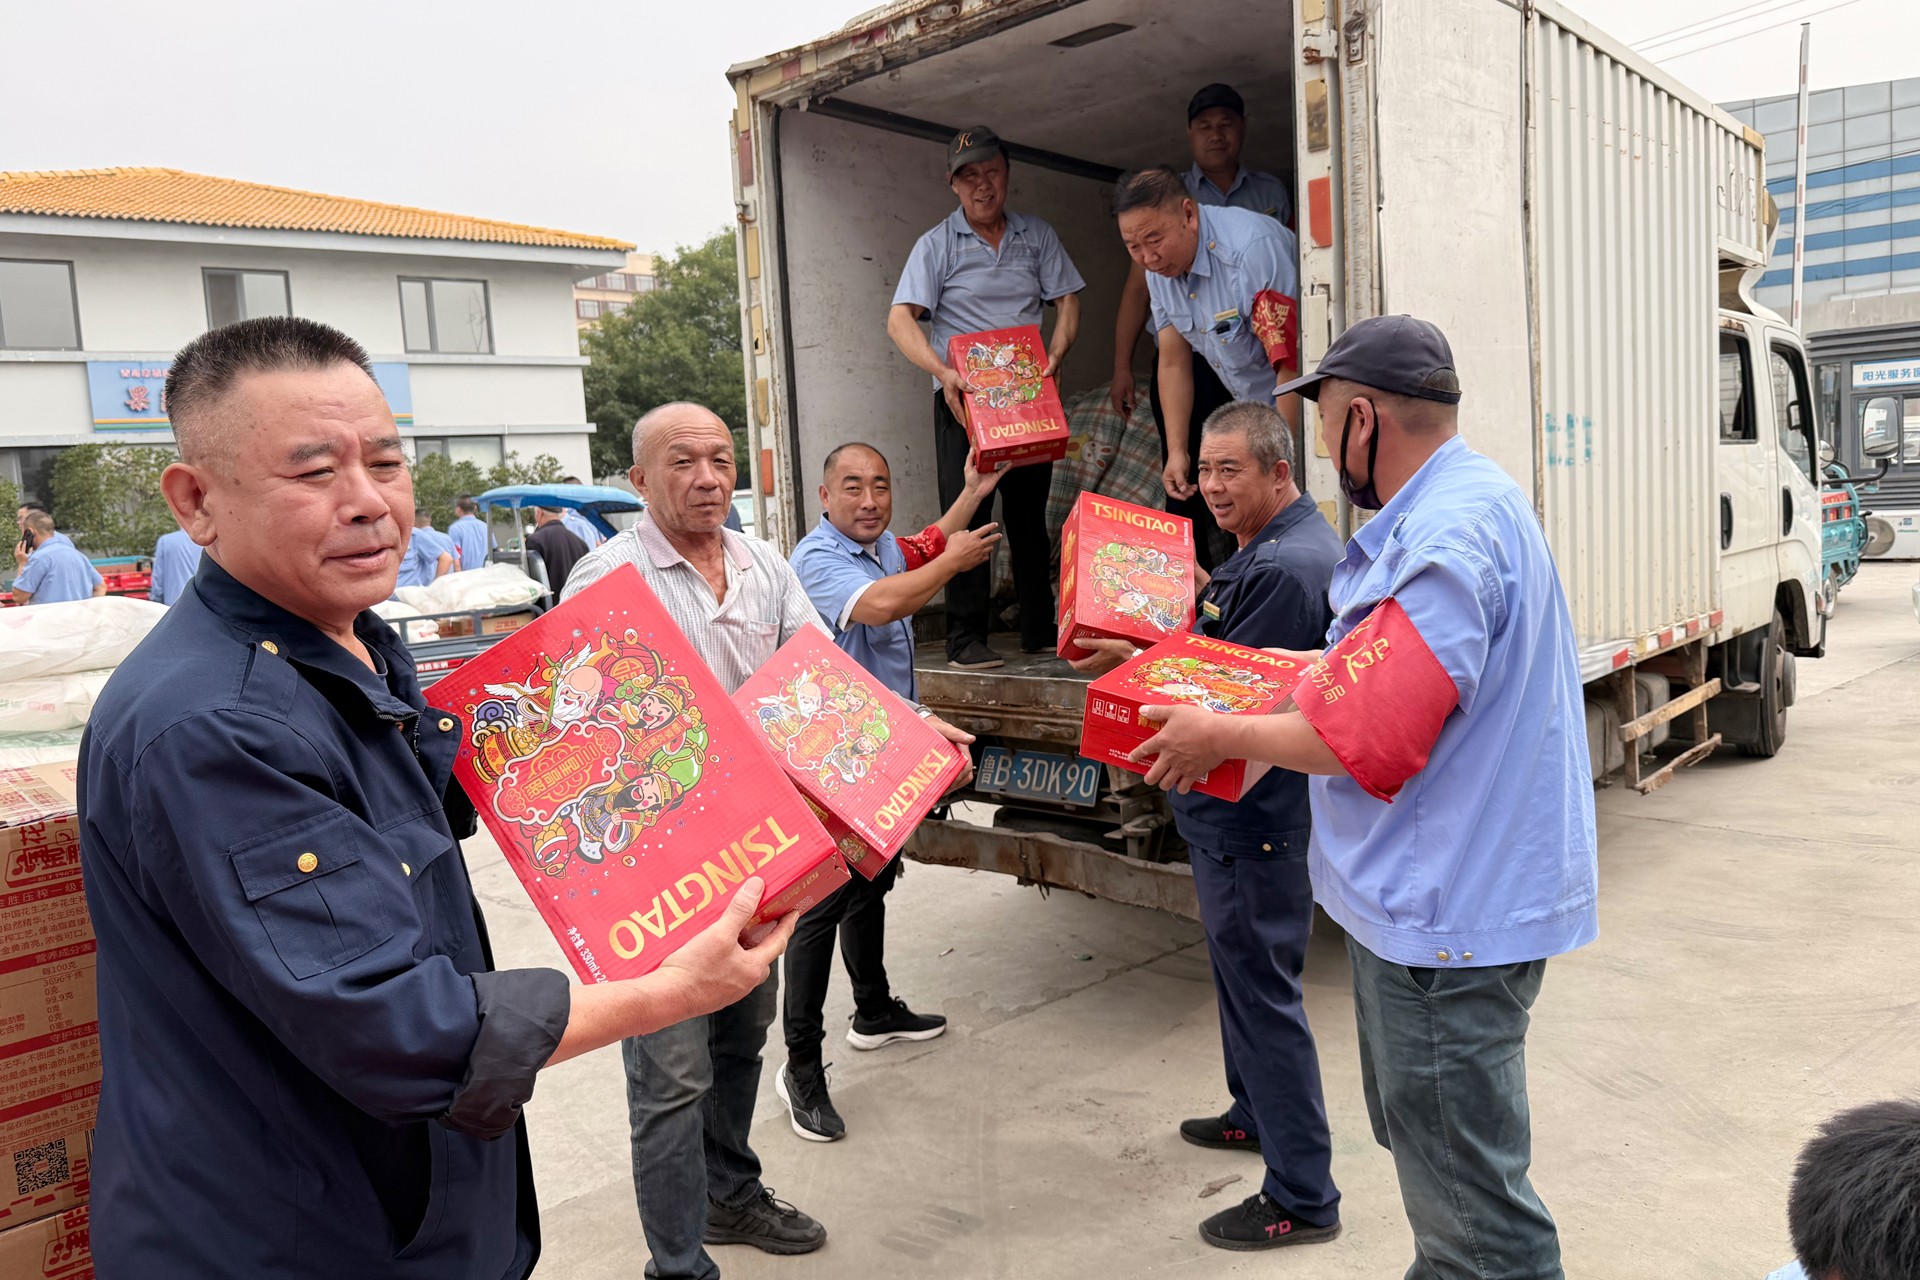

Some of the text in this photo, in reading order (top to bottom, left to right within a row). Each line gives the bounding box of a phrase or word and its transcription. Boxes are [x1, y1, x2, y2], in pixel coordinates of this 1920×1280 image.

[955, 132, 974, 154] K
[988, 417, 1061, 440] TSINGTAO
[1090, 501, 1178, 537] TSINGTAO
[1184, 636, 1297, 670] TSINGTAO
[980, 753, 1098, 799] 鲁B·3DK90
[873, 747, 952, 831] TSINGTAO
[608, 815, 800, 960] TSINGTAO
[35, 943, 93, 963] 营养成分表
[45, 991, 74, 1005] 99.9克
[49, 1023, 100, 1043] 守护花生
[1264, 1219, 1292, 1240] TD
